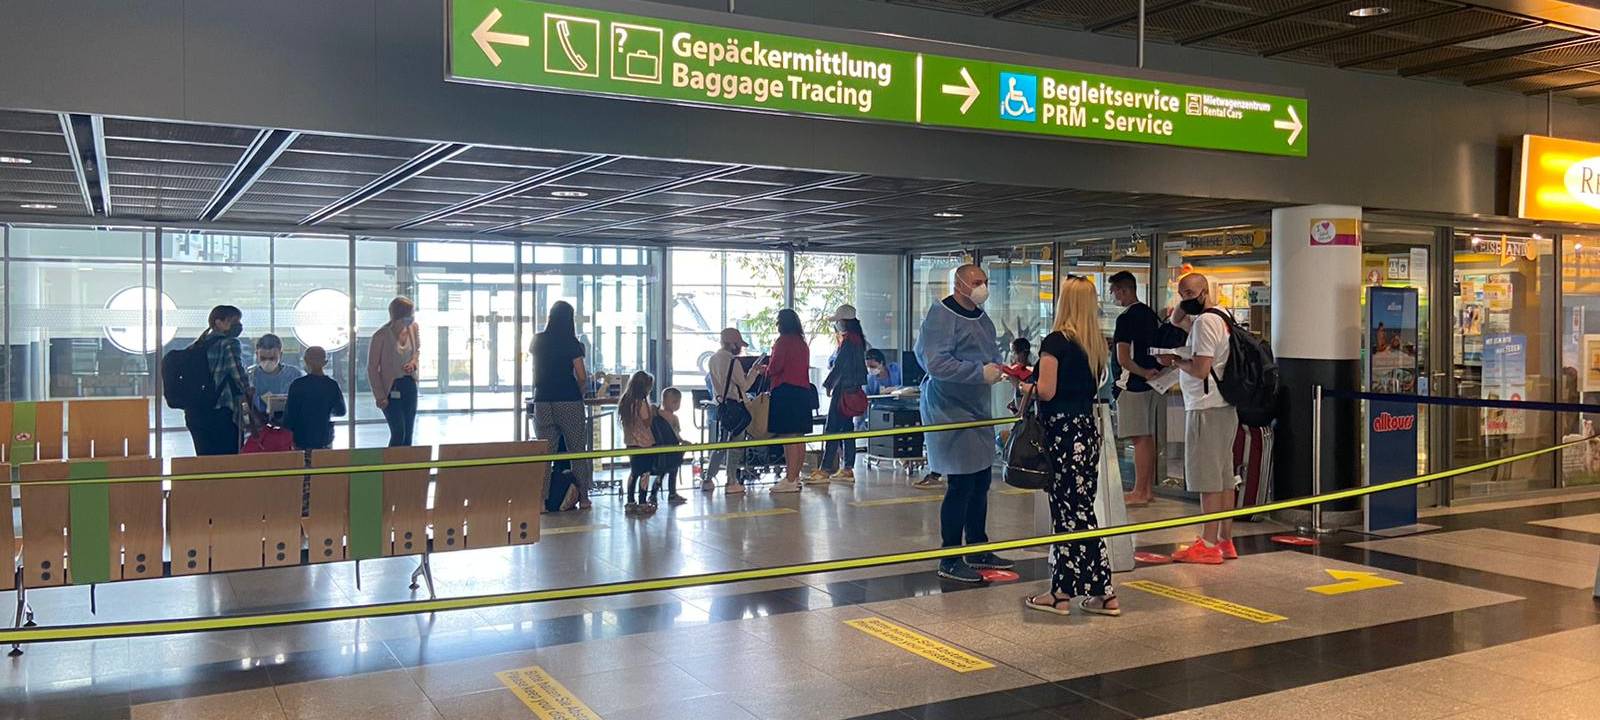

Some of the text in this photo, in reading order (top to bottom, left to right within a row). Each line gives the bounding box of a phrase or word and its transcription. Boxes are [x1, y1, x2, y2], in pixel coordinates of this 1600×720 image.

[672, 31, 892, 85] Gepäckermittlung
[672, 63, 873, 112] Baggage Tracing
[1042, 76, 1180, 113] Begleitservice
[1203, 94, 1271, 112] Mietwagenzentrum
[1042, 103, 1087, 128] PRM
[1104, 109, 1173, 136] Service
[1203, 105, 1243, 119] Rental Cars
[1373, 412, 1414, 432] alltours
